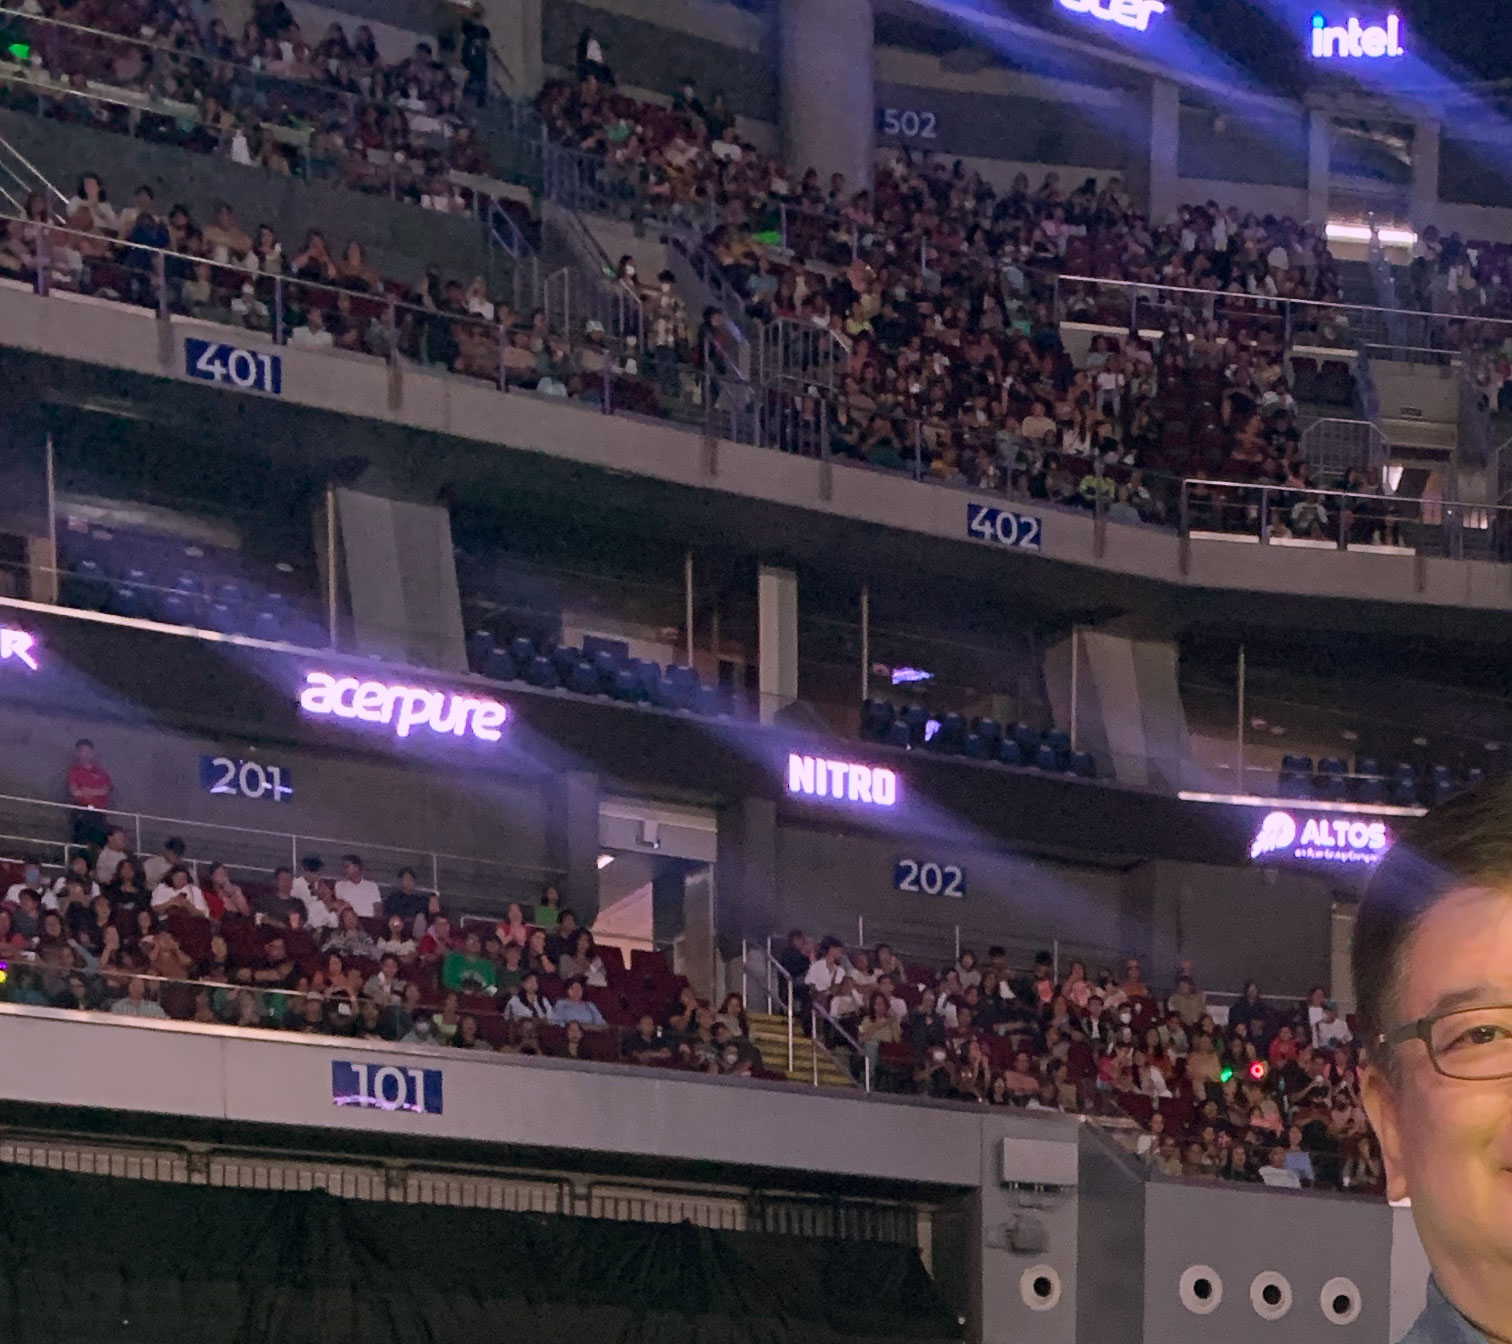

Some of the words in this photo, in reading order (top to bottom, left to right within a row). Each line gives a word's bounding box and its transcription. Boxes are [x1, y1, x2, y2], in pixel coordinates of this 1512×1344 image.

[884, 109, 937, 138] 502
[197, 344, 272, 392] 401
[971, 508, 1039, 549] 402
[301, 672, 506, 741] acerpure
[210, 757, 280, 801] 201
[789, 754, 896, 805] NITRO
[1300, 819, 1387, 849] ALTOS
[899, 859, 963, 897] 202
[351, 1064, 424, 1112] 101
